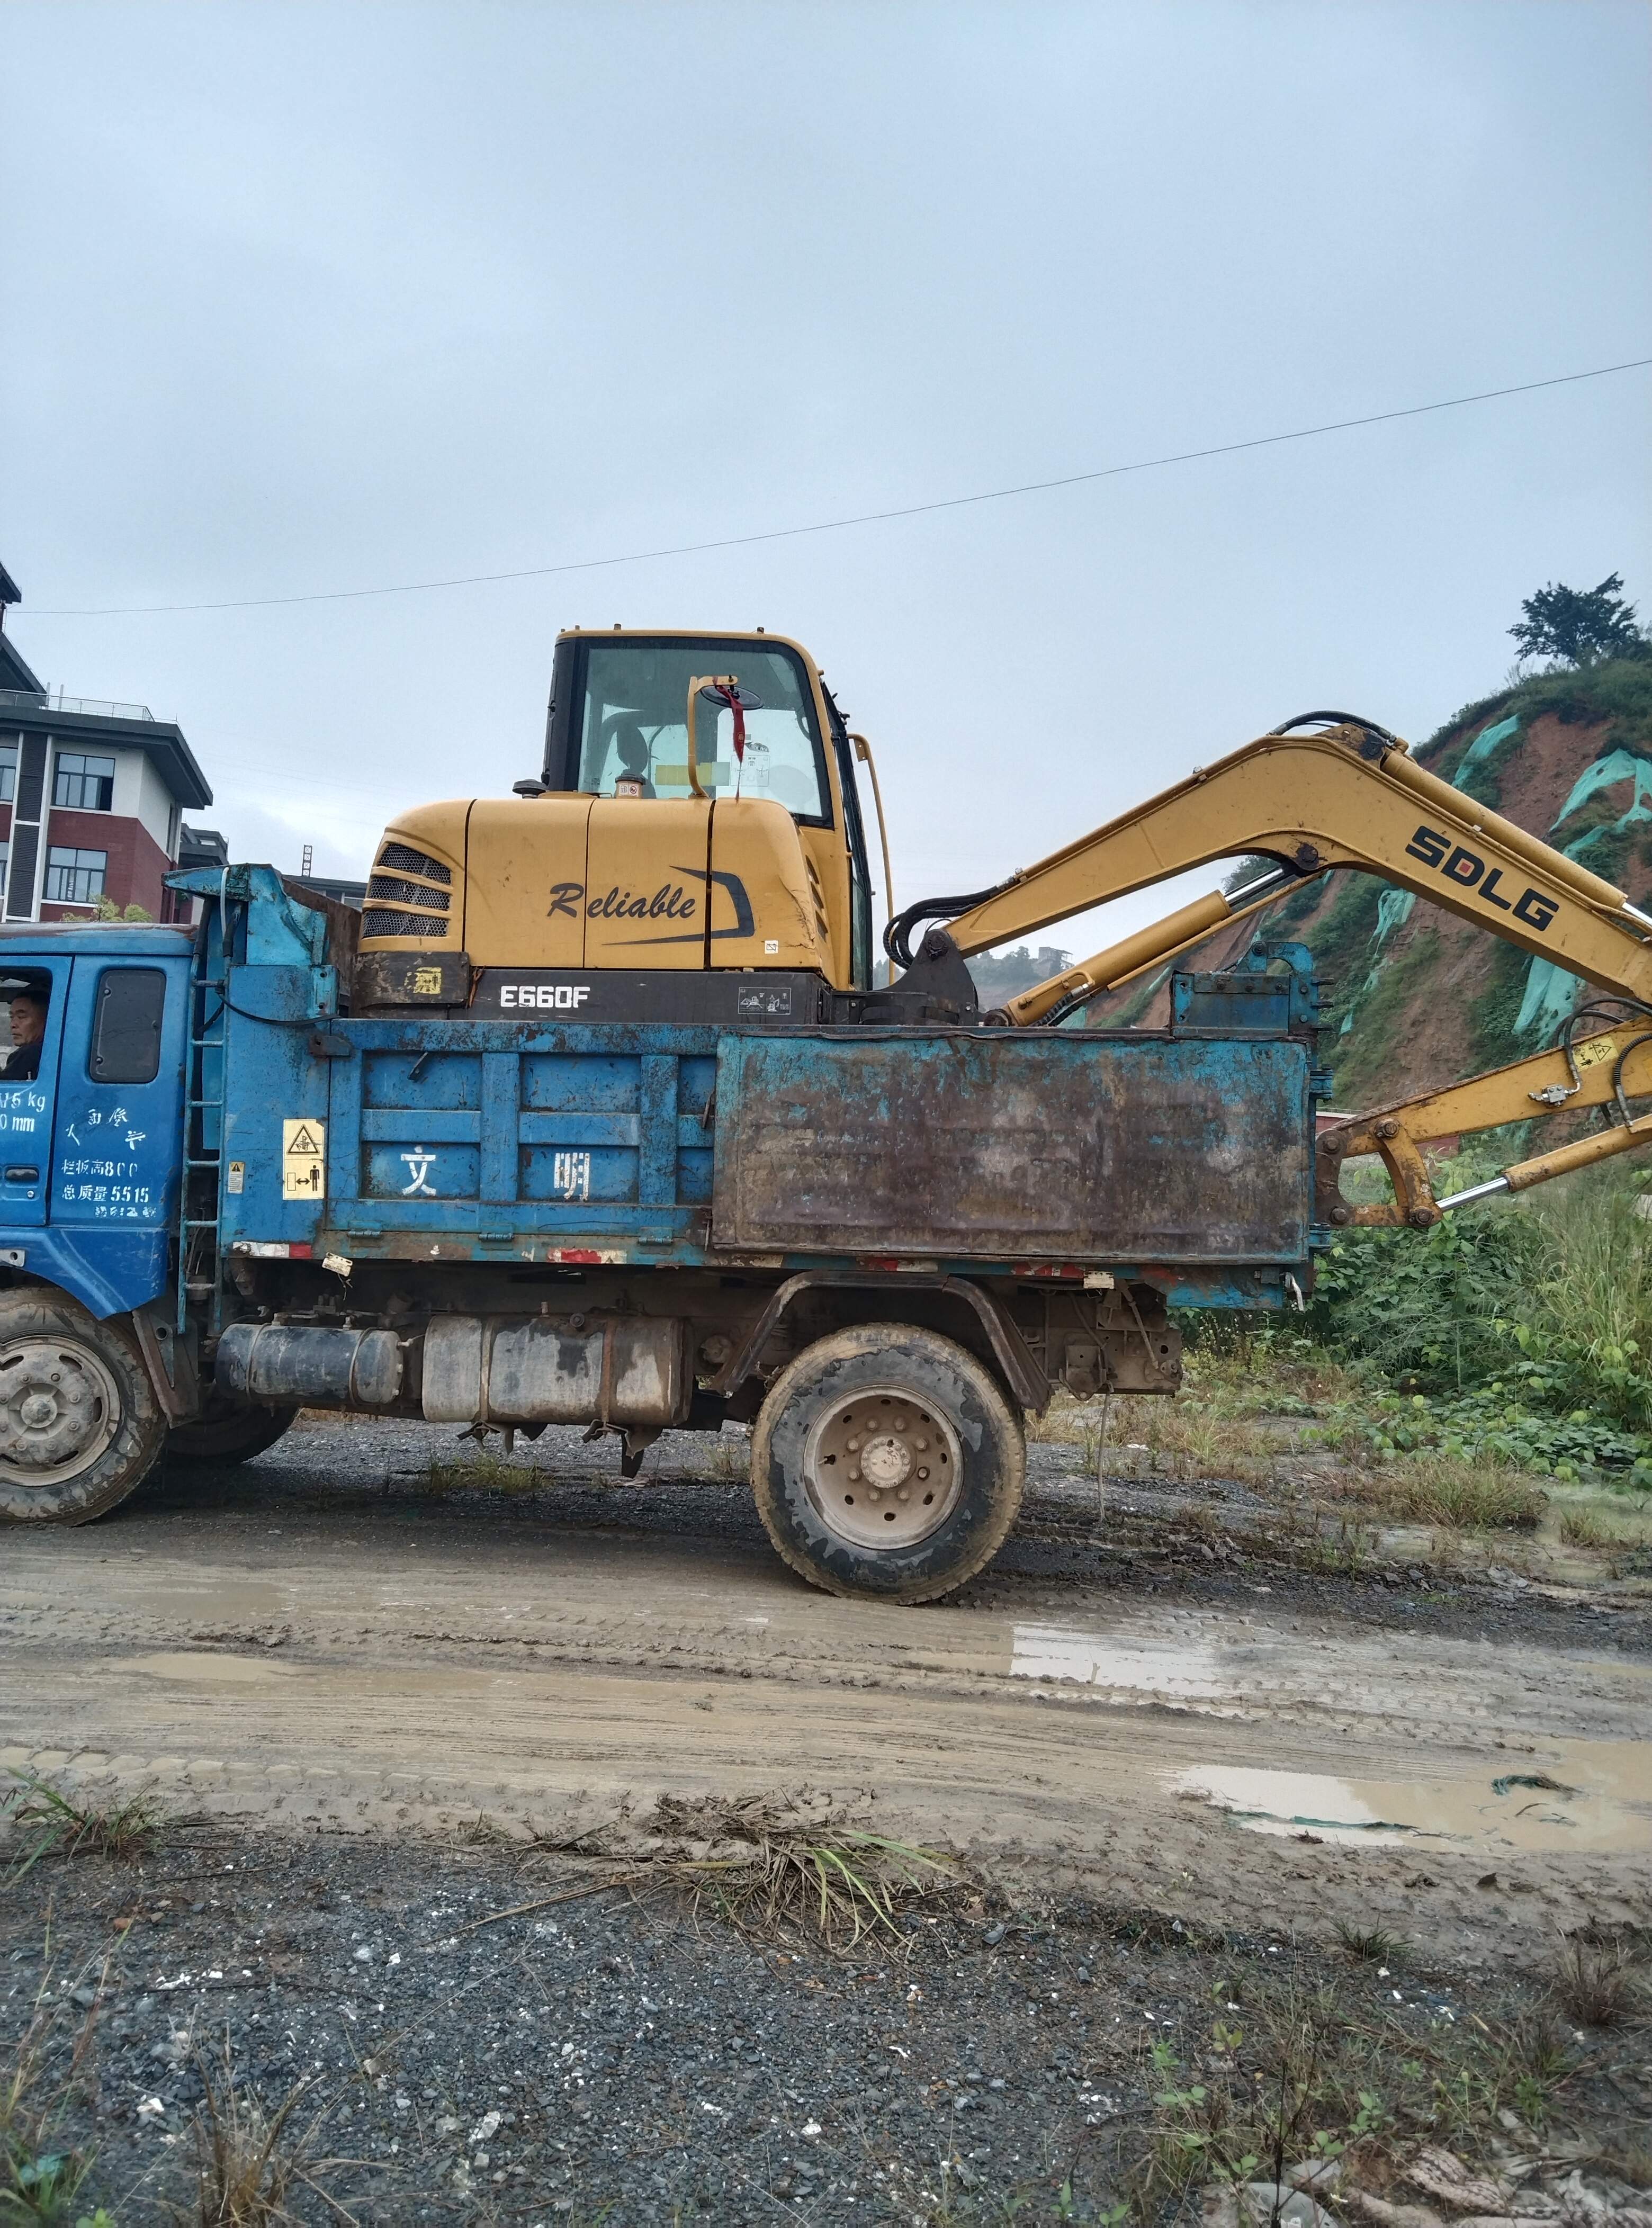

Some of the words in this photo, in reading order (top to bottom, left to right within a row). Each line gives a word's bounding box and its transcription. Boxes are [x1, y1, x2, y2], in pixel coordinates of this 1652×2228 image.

[1405, 825, 1559, 932] SDLG
[546, 883, 695, 919] Reliable
[501, 986, 590, 1008] E660F
[28, 1091, 46, 1112] kg
[12, 1117, 34, 1132] mm
[401, 1146, 436, 1196] 文
[554, 1152, 590, 1201] 明
